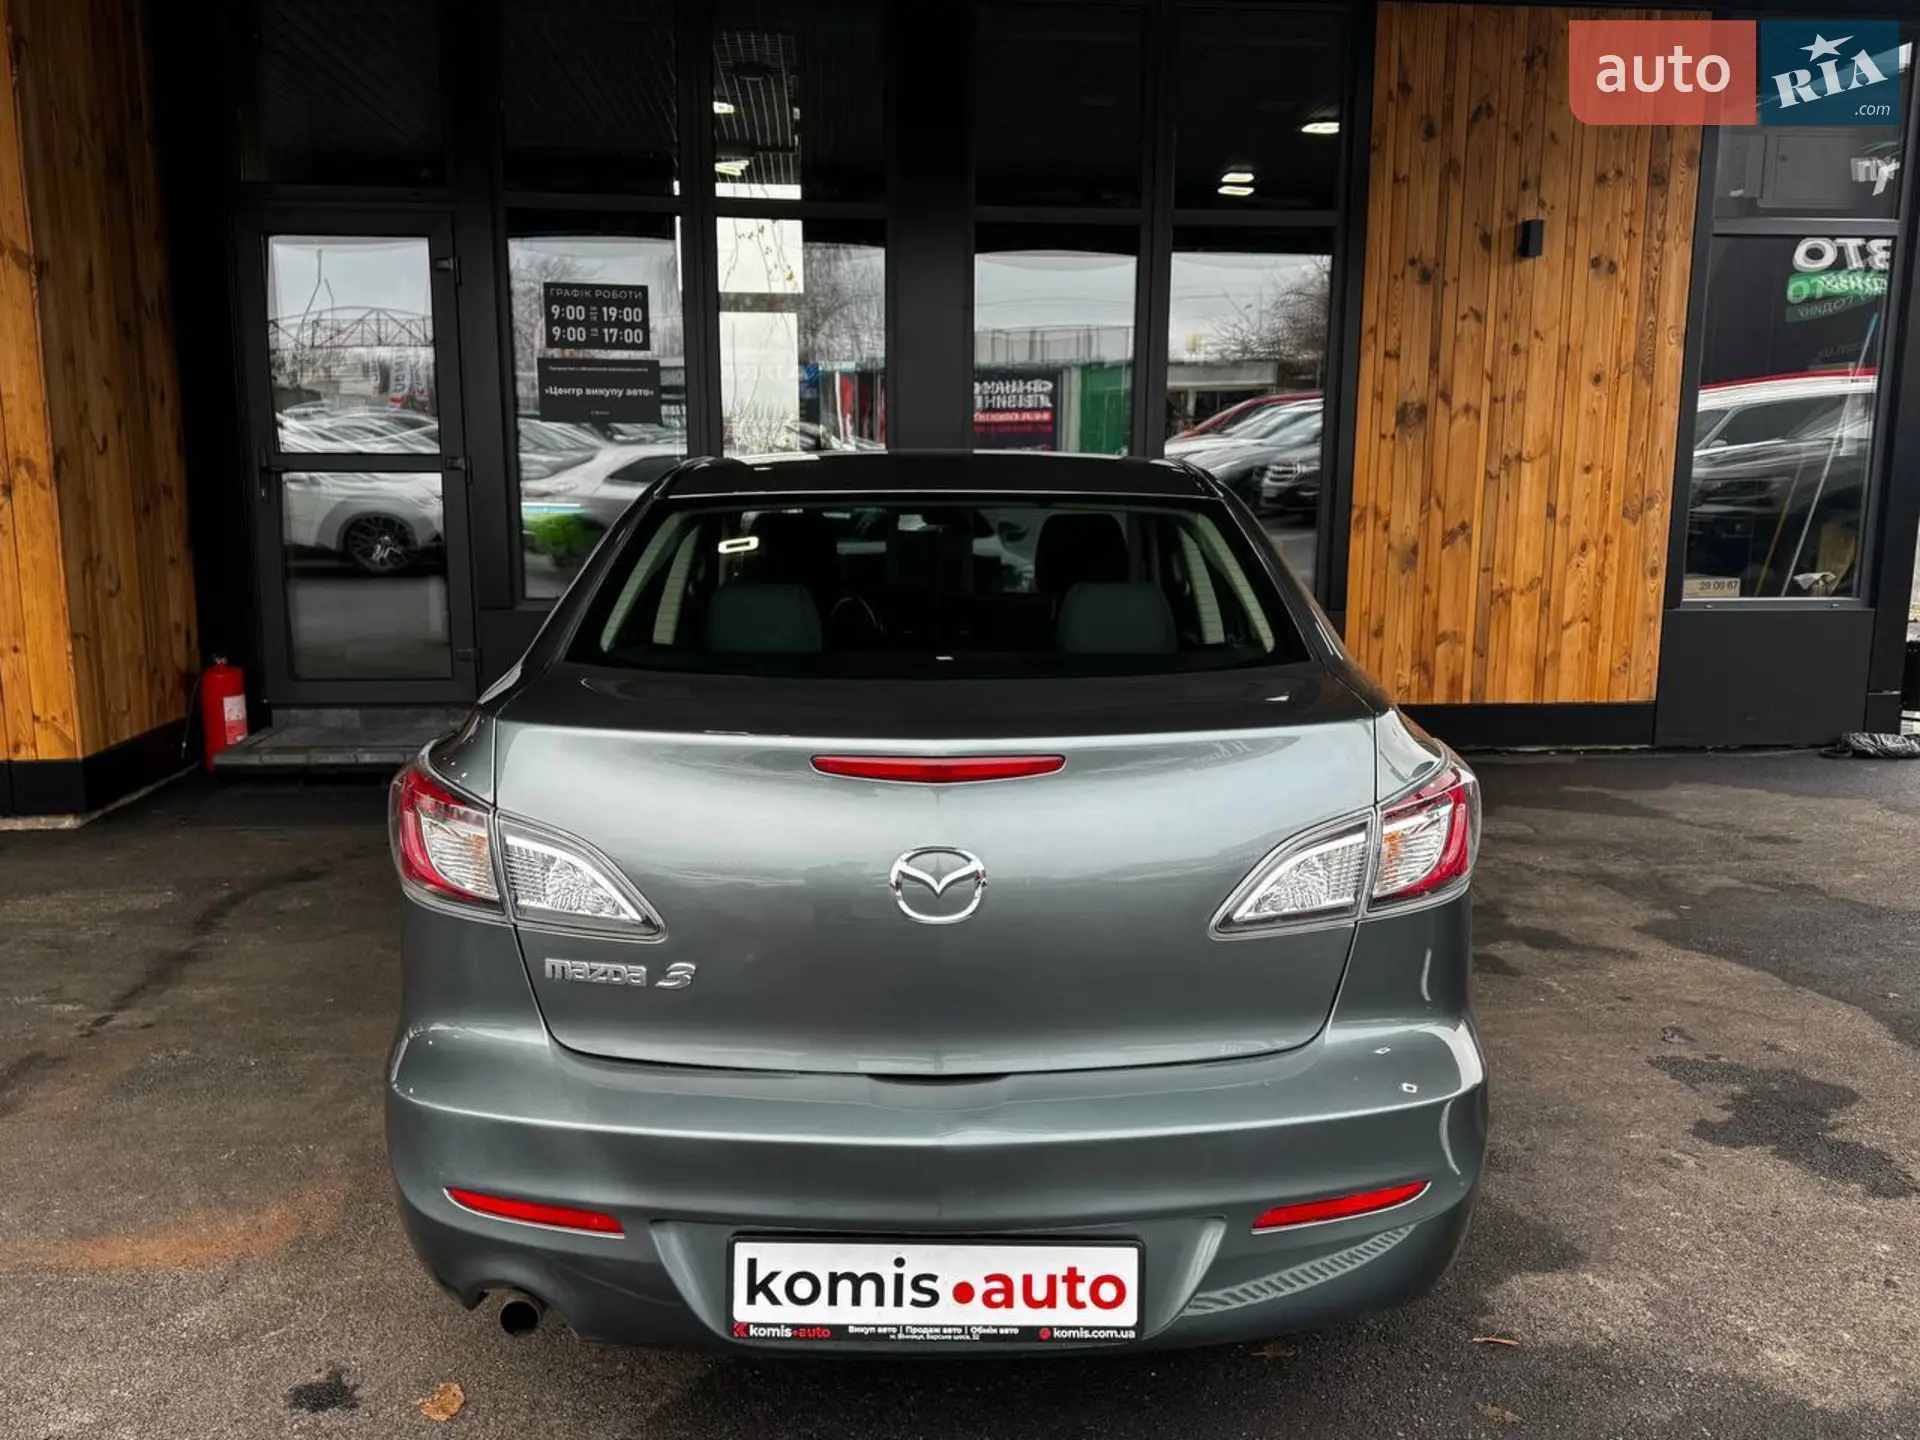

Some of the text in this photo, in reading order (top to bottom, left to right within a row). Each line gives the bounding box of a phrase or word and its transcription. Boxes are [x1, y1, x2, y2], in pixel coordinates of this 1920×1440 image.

[549, 287, 642, 300] ГРАФІК РОБОТИ
[551, 304, 586, 321] 9:00
[602, 305, 643, 323] 19:00
[552, 325, 587, 342] 9:00
[603, 328, 644, 344] 17:00
[585, 387, 624, 400] викупу
[746, 1256, 1127, 1310] komis auto
[749, 1324, 833, 1338] komis auto
[848, 1325, 876, 1335] Викуп
[905, 1325, 941, 1335] Продаж
[999, 1327, 1020, 1335] авто
[1053, 1327, 1136, 1339] komis.com.ua
